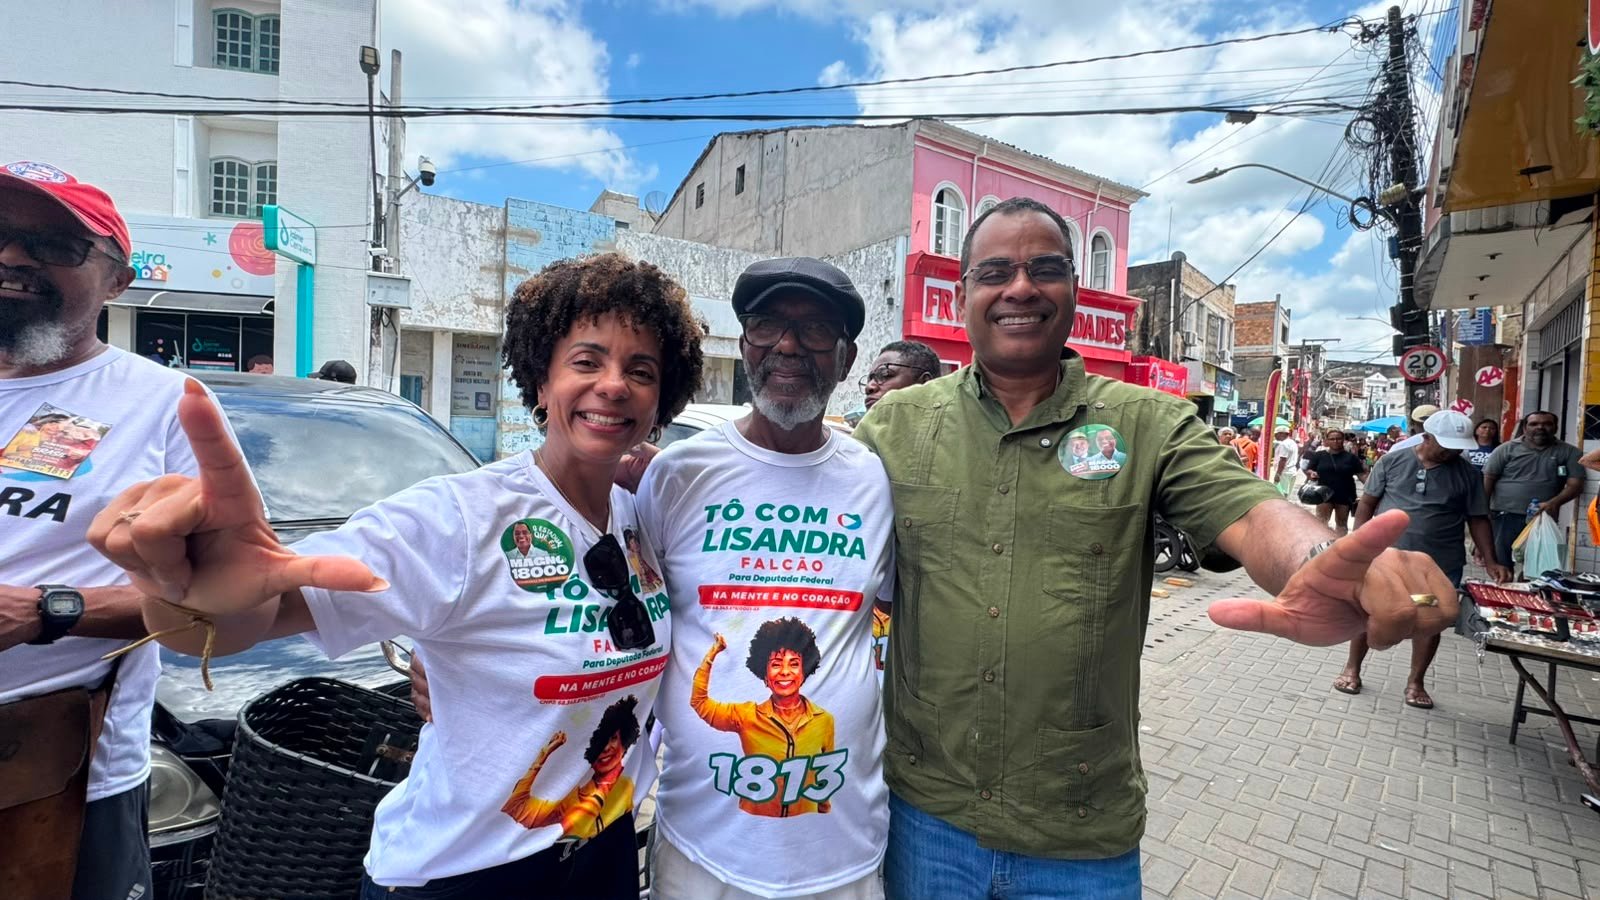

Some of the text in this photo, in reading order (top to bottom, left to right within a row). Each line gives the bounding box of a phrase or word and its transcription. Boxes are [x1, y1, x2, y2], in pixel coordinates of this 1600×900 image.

[1072, 311, 1125, 345] DADES
[1407, 353, 1438, 369] 20
[704, 498, 829, 525] TÔ COM
[702, 526, 867, 560] LISANDRA
[511, 564, 569, 580] 18000
[741, 556, 824, 572] FALCÃO
[728, 573, 834, 585] Para Deputada Federal
[712, 591, 851, 605] NA MENTE E NO CORAÇÃO
[544, 592, 671, 635] LISARA
[582, 659, 605, 669] Para
[606, 652, 641, 667] Deputada
[559, 683, 578, 692] NA
[582, 675, 616, 691] MENTE
[617, 673, 623, 682] E
[624, 669, 637, 680] NO
[709, 748, 849, 805] 1813
